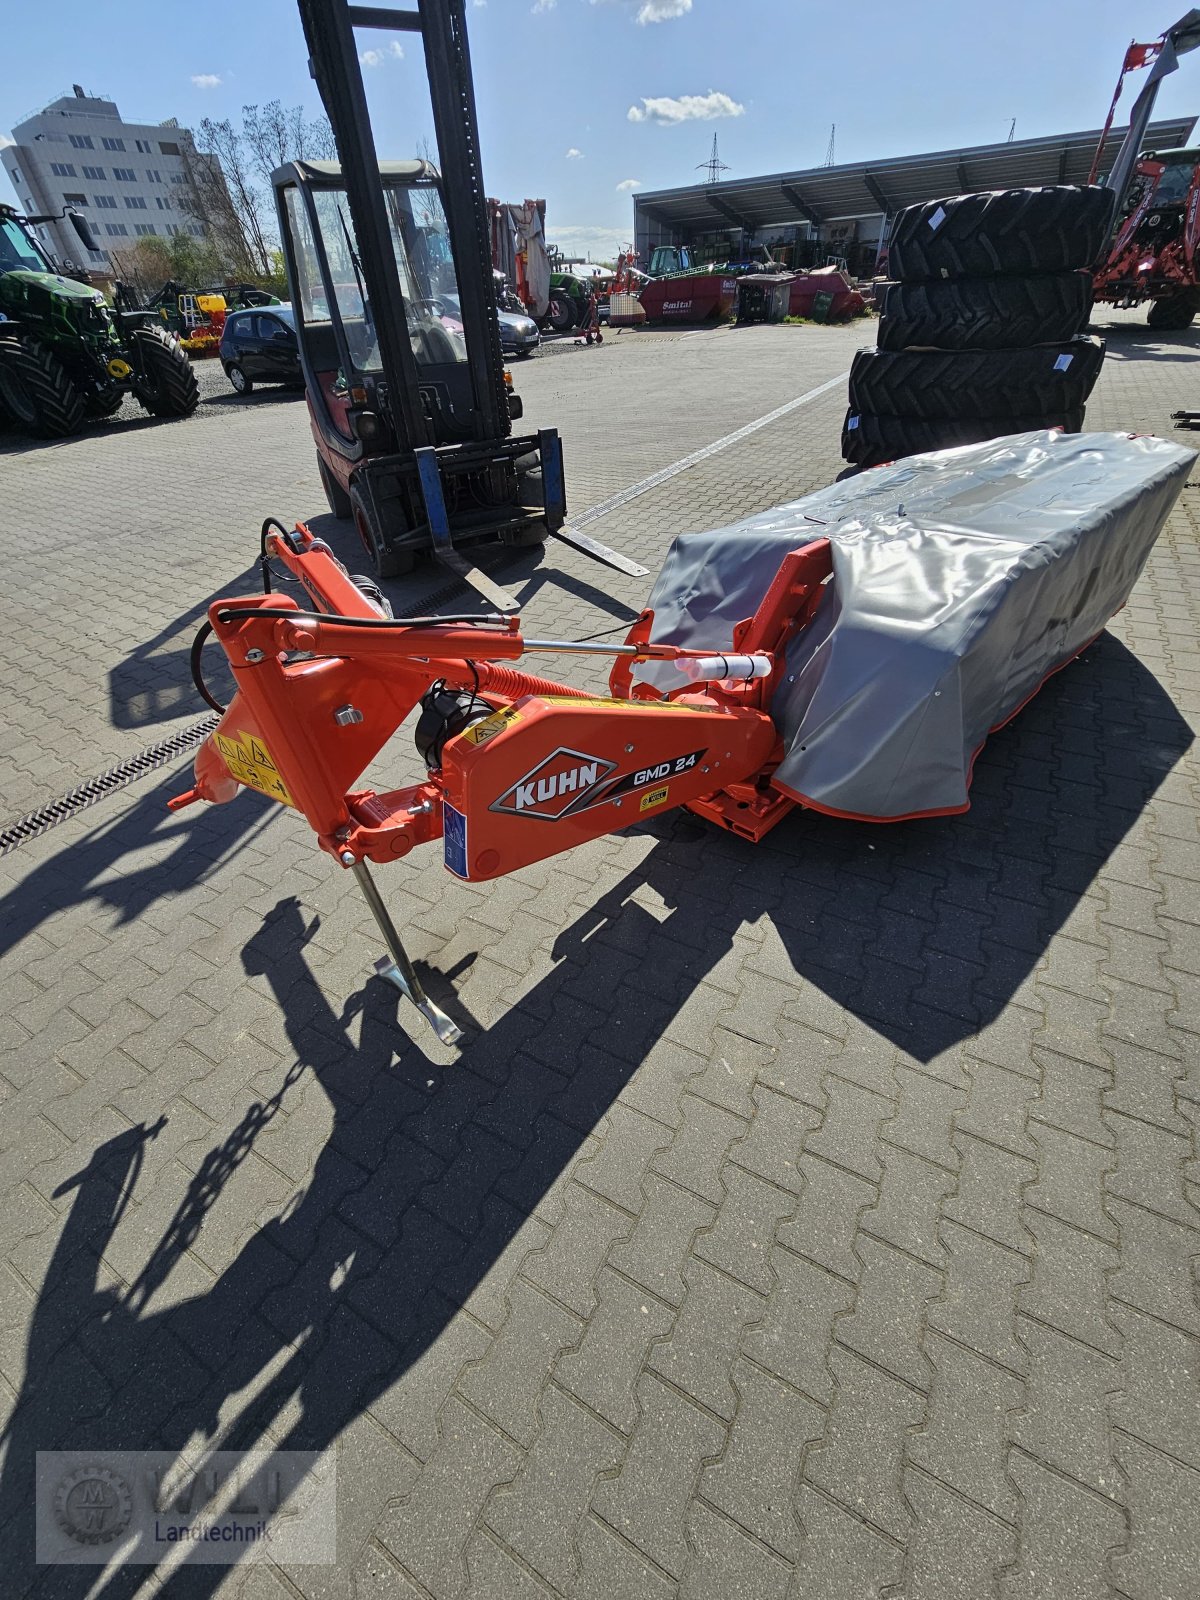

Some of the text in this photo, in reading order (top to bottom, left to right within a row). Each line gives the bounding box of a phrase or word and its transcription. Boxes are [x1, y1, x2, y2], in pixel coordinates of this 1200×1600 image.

[515, 762, 598, 810] KUHN
[633, 754, 696, 786] GMD 24
